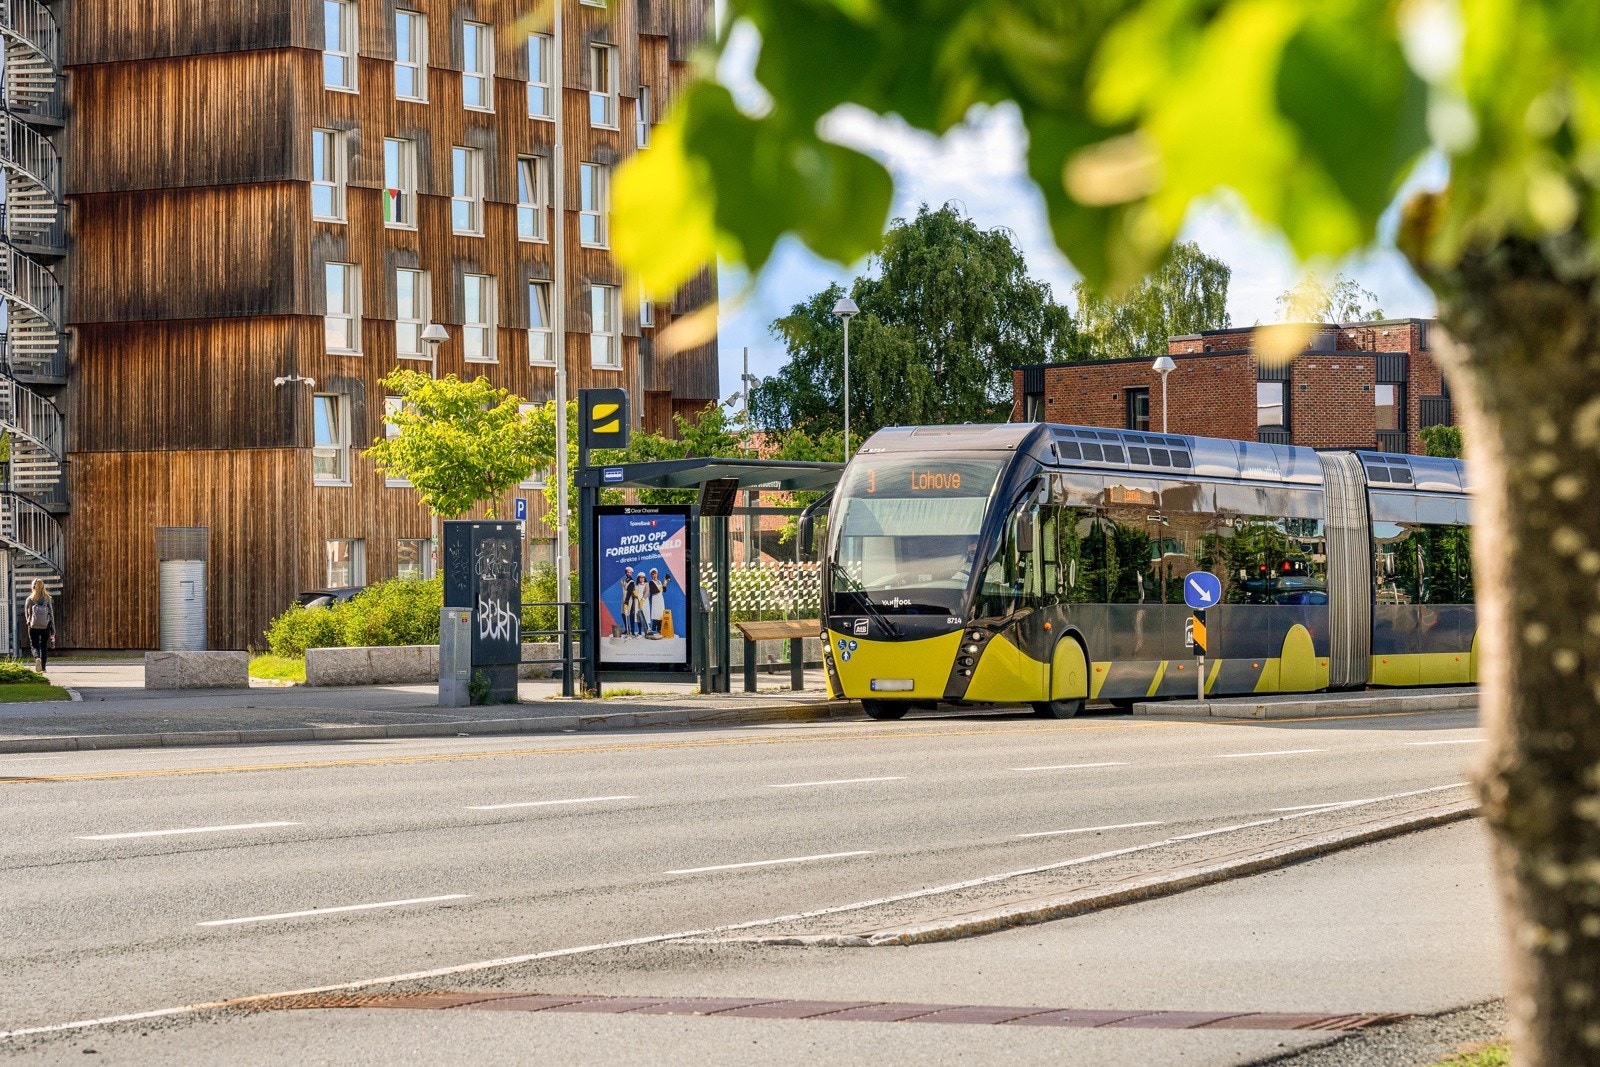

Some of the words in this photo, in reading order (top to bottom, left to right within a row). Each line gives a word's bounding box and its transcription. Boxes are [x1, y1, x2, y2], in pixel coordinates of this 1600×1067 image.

[911, 470, 961, 490] Lohove
[517, 501, 525, 517] P
[620, 534, 646, 546] RYDD
[648, 531, 667, 541] OPP
[605, 539, 682, 557] FORBRUKSGJELD
[620, 556, 638, 564] direkte
